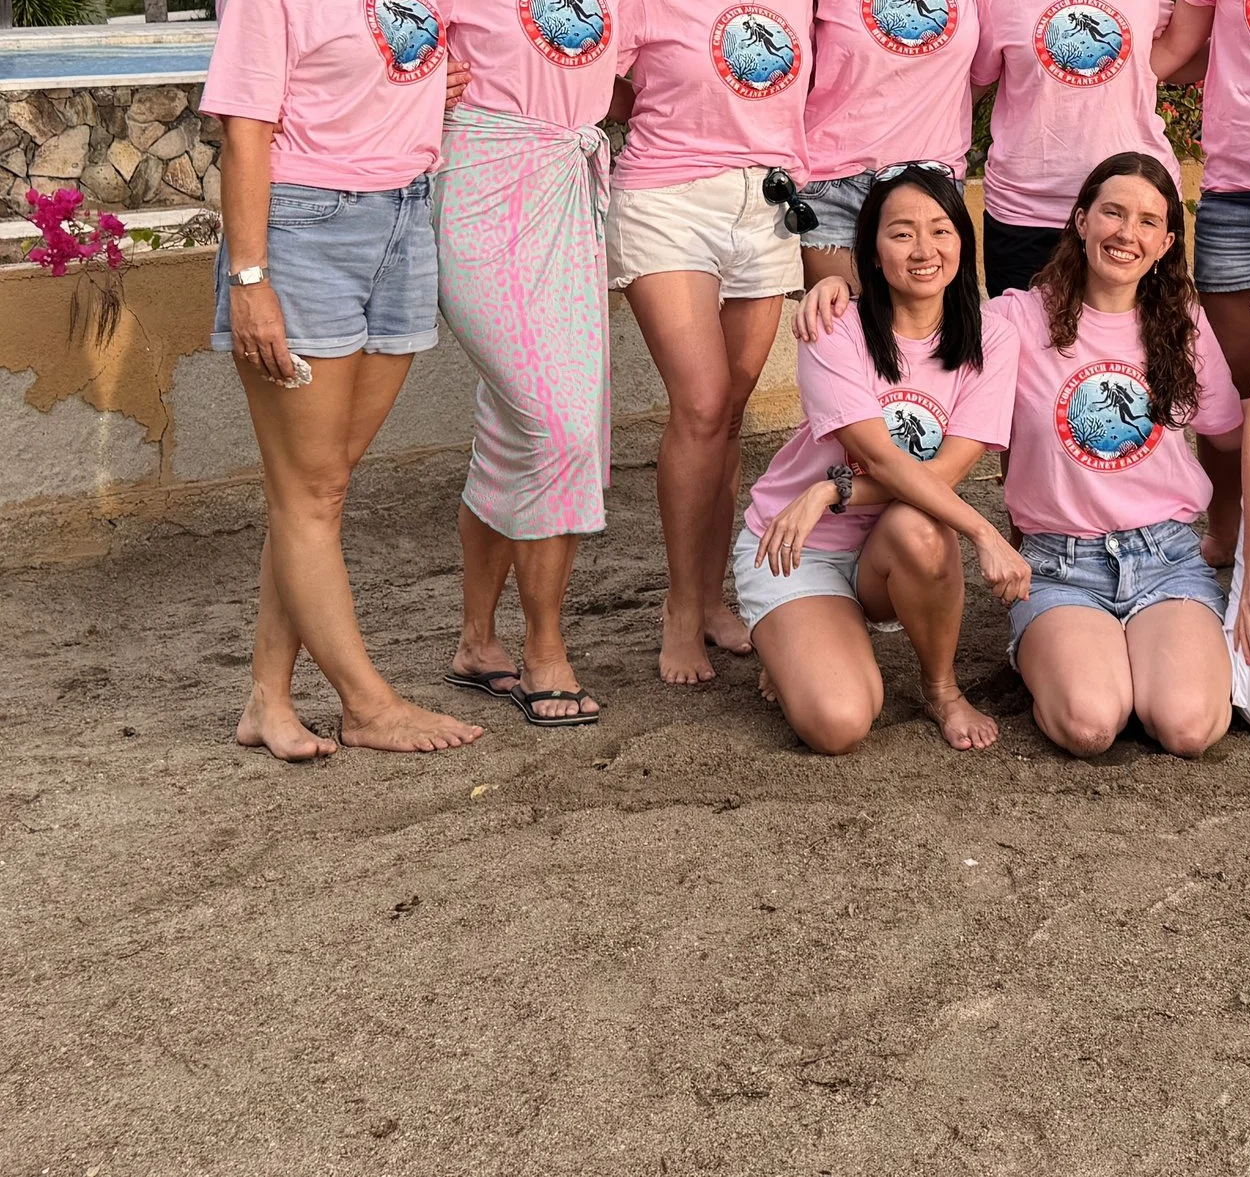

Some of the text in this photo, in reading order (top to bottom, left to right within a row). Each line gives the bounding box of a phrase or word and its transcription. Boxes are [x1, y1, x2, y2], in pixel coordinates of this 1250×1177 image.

[714, 24, 724, 46] CORAL
[722, 8, 743, 22] CATCH
[744, 6, 786, 26] ADVENTURE
[1036, 20, 1048, 38] CORAL
[1048, 0, 1070, 15] CATCH
[582, 43, 604, 63] EARTH
[872, 28, 948, 54] HER PLANET EARTH
[423, 46, 444, 74] EARTH
[1048, 58, 1124, 84] HER PLANET EARTH
[725, 74, 794, 96] HER PLANET EARTH
[1060, 378, 1080, 404] CORAL
[1079, 364, 1106, 378] CATCH
[880, 392, 903, 406] CATCH
[1064, 440, 1150, 468] HER PLANET EARTH
